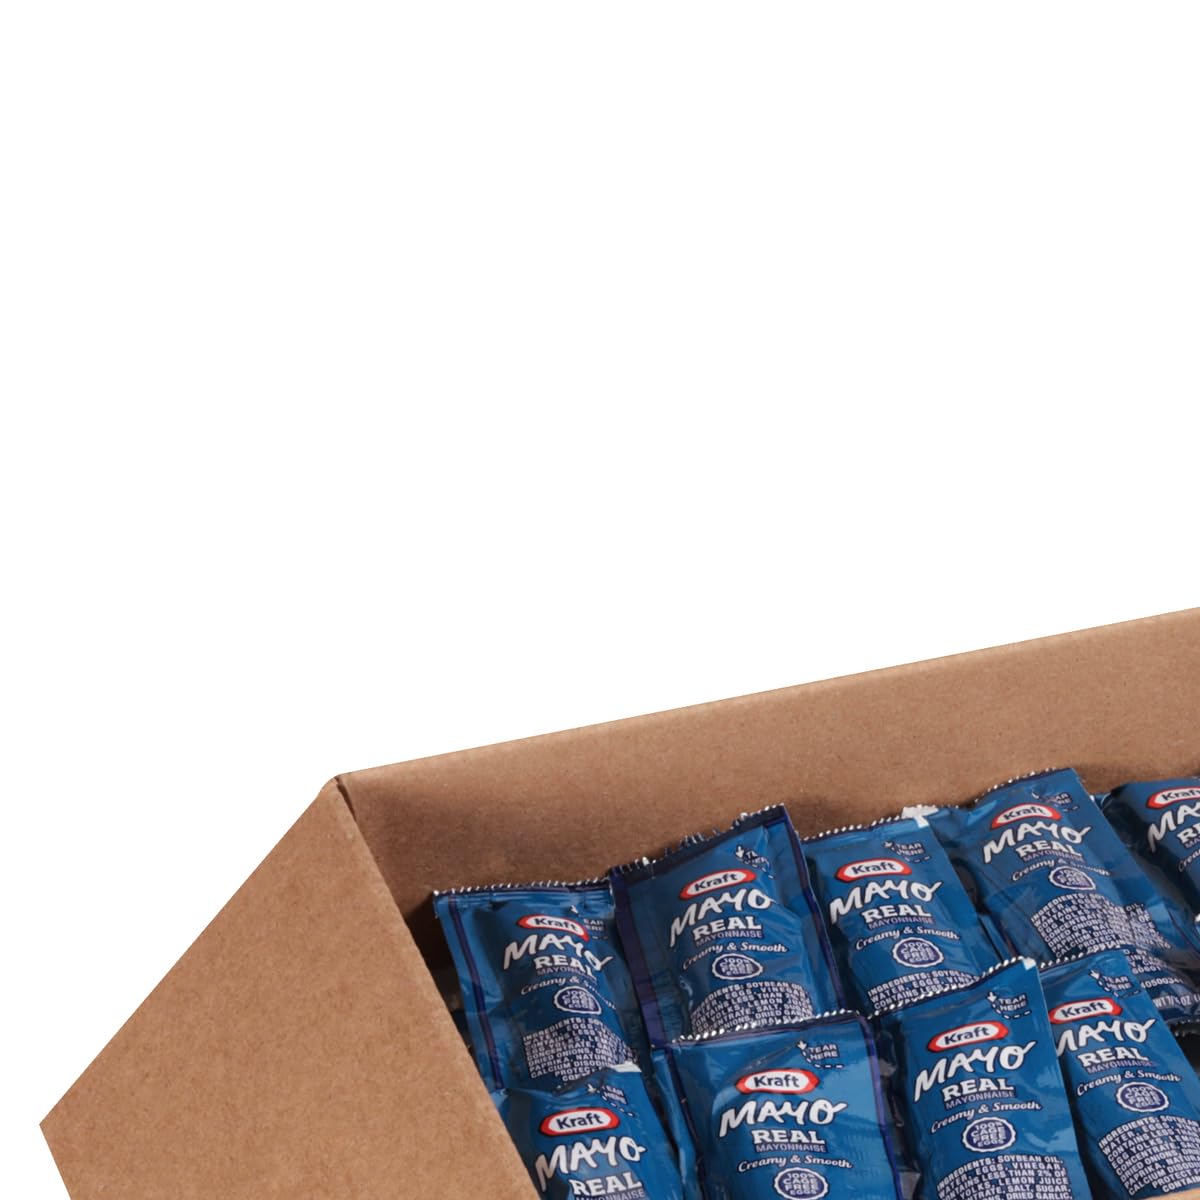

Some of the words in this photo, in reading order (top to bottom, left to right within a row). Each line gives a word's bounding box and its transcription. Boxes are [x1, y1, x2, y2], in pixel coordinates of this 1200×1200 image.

[1003, 806, 1045, 820] Kraft
[983, 821, 1092, 864] MAYO
[1016, 840, 1082, 857] REAL
[852, 861, 895, 875] Kraft
[1012, 859, 1054, 881] Creamy
[694, 873, 738, 891] Kraft
[830, 880, 942, 925] MAYO
[670, 888, 777, 947] MAYO
[861, 905, 932, 924] REAL
[868, 916, 936, 929] MAYONNAISE
[534, 918, 579, 931] Kraft
[692, 916, 762, 941] REAL
[695, 930, 762, 947] MAYONNAISE
[855, 928, 900, 950] Creamy
[903, 926, 913, 934] &
[917, 926, 960, 940] Smooth
[504, 934, 613, 970] MAYO
[683, 944, 723, 970] Creamy
[727, 942, 736, 951] &
[740, 942, 788, 953] Smooth
[521, 976, 566, 995] Creamy
[998, 994, 1026, 1005] TEAR
[1000, 1002, 1028, 1012] HERE
[1062, 1001, 1107, 1018] Kraft
[944, 1027, 990, 1044] Kraft
[810, 1043, 837, 1053] TEAR
[810, 1050, 838, 1060] HERE
[1078, 1046, 1149, 1067] REAL
[914, 1041, 1036, 1102] MAYO
[754, 1074, 800, 1088] Kraft
[942, 1078, 1014, 1102] REAL
[1077, 1073, 1121, 1096] Creamy
[1124, 1070, 1135, 1079] &
[1137, 1070, 1181, 1082] Smooth
[945, 1091, 1015, 1109] MAYONNAISE
[557, 1113, 603, 1129] Kraft
[719, 1099, 848, 1138] MAYO
[931, 1108, 974, 1133] Creamy
[978, 1103, 990, 1113] &
[993, 1102, 1042, 1112] Smooth
[751, 1129, 825, 1145] REAL
[971, 1128, 1005, 1138] CAGE
[973, 1134, 1007, 1144] FREE
[1098, 1116, 1160, 1148] INGREDIENTS:
[756, 1143, 826, 1153] MAYONNAISE
[535, 1136, 647, 1192] MAYO
[738, 1156, 786, 1173] Creamy
[790, 1155, 801, 1164] &
[805, 1155, 852, 1169] Smooth
[937, 1158, 995, 1190] INGREDIENTS:
[998, 1155, 1042, 1163] SOYBEAN
[569, 1172, 642, 1197] REAL
[939, 1174, 972, 1199] WATER,
[976, 1164, 1008, 1176] EGGS,
[1012, 1162, 1065, 1171] VINEGAR,
[982, 1171, 1006, 1180] LESS
[960, 1182, 995, 1199] YOLKS,
[999, 1177, 1035, 1186] LEMON
[1007, 1192, 1033, 1200] DRIED
[1008, 1184, 1034, 1193] SALT,
